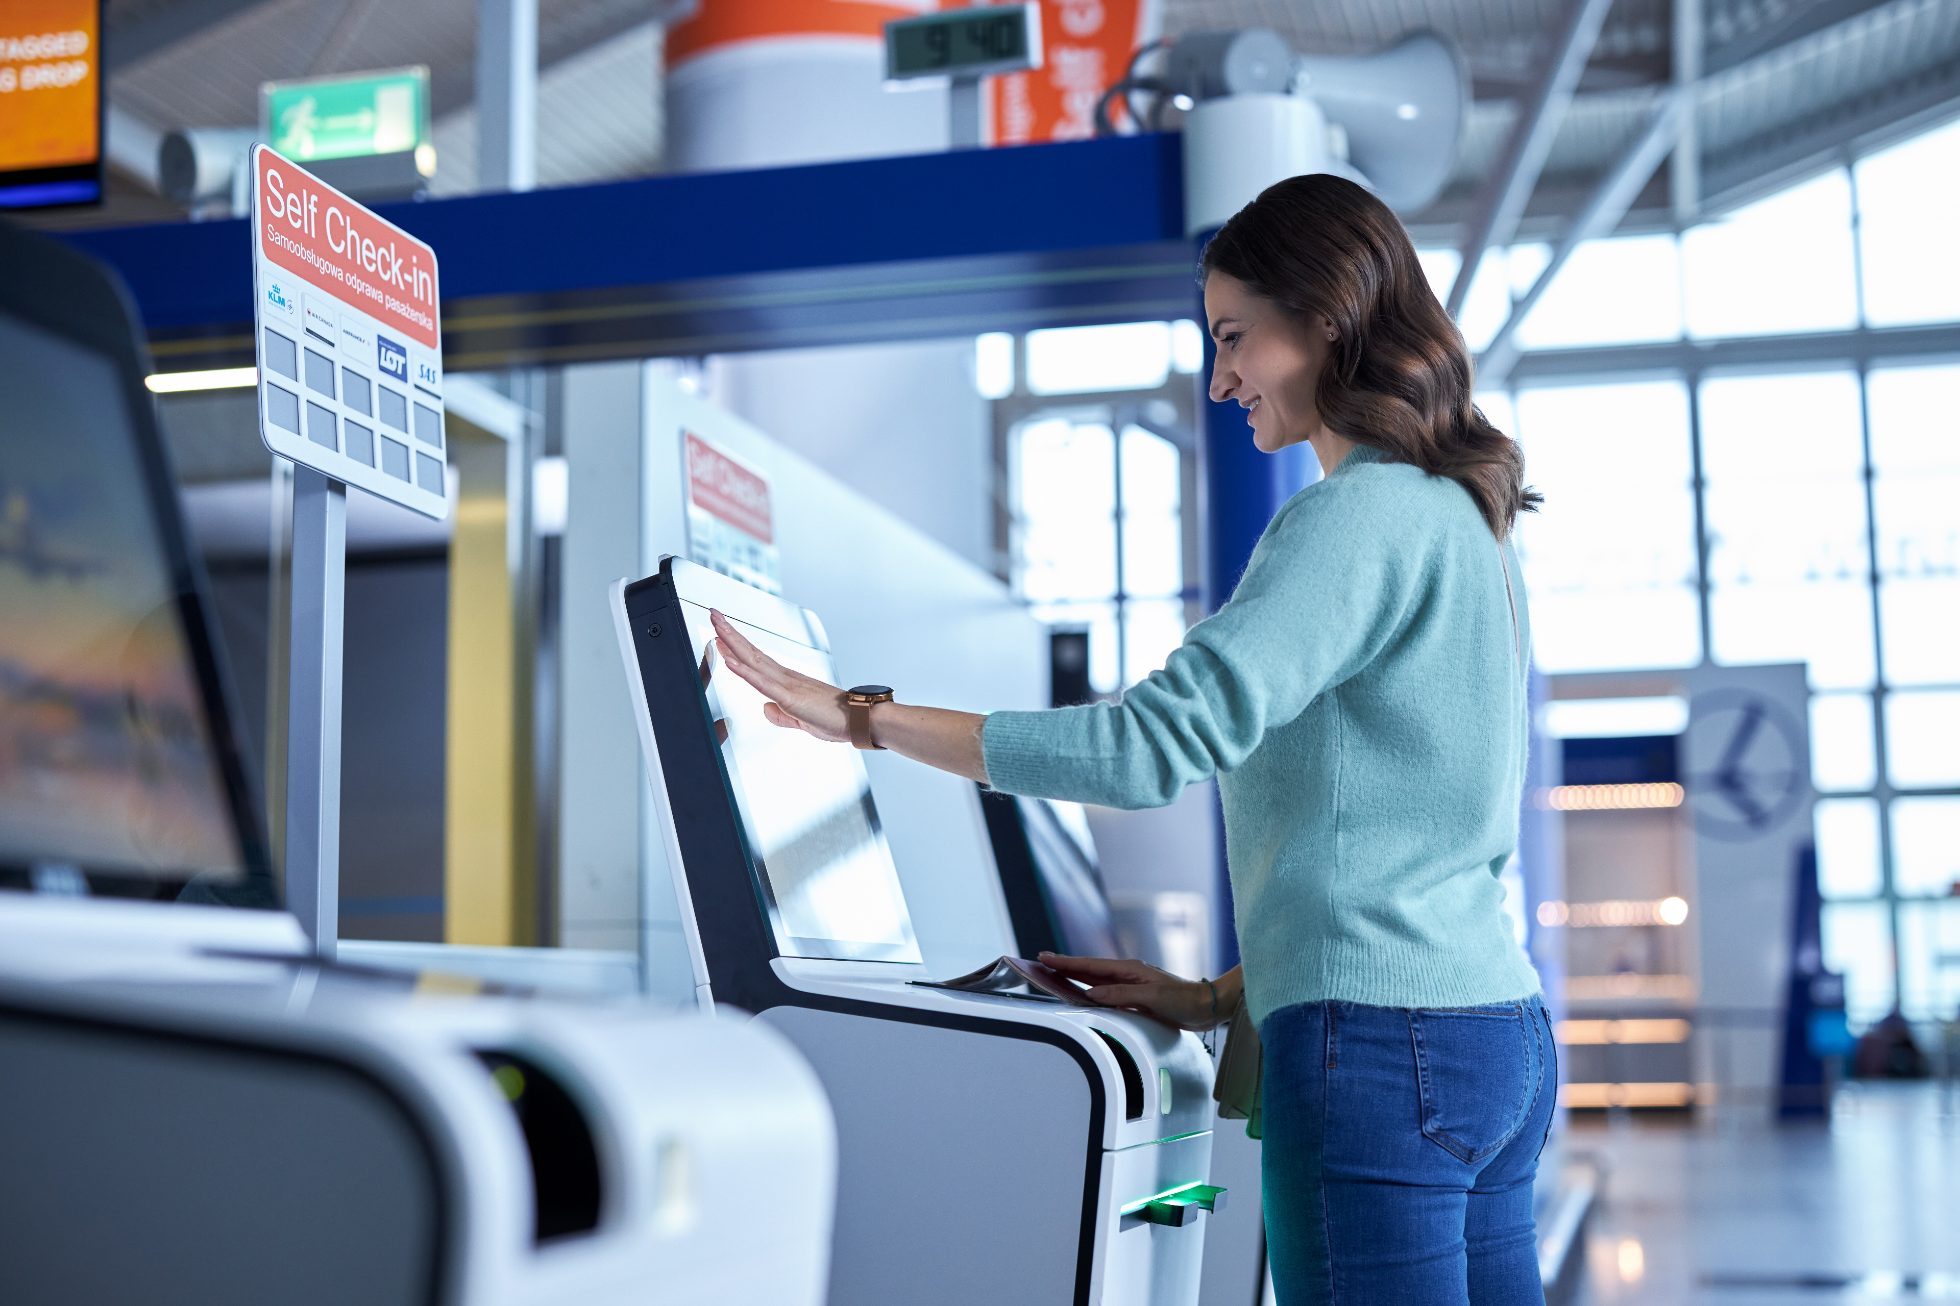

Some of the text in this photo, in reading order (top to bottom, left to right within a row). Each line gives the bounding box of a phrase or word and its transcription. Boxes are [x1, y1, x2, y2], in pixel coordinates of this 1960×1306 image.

[266, 168, 433, 306] Self Check-in
[267, 223, 433, 331] Samoobsługowa odprawa pasażerska
[267, 290, 286, 308] KLM
[379, 346, 406, 375] LOT
[418, 363, 437, 384] SAS
